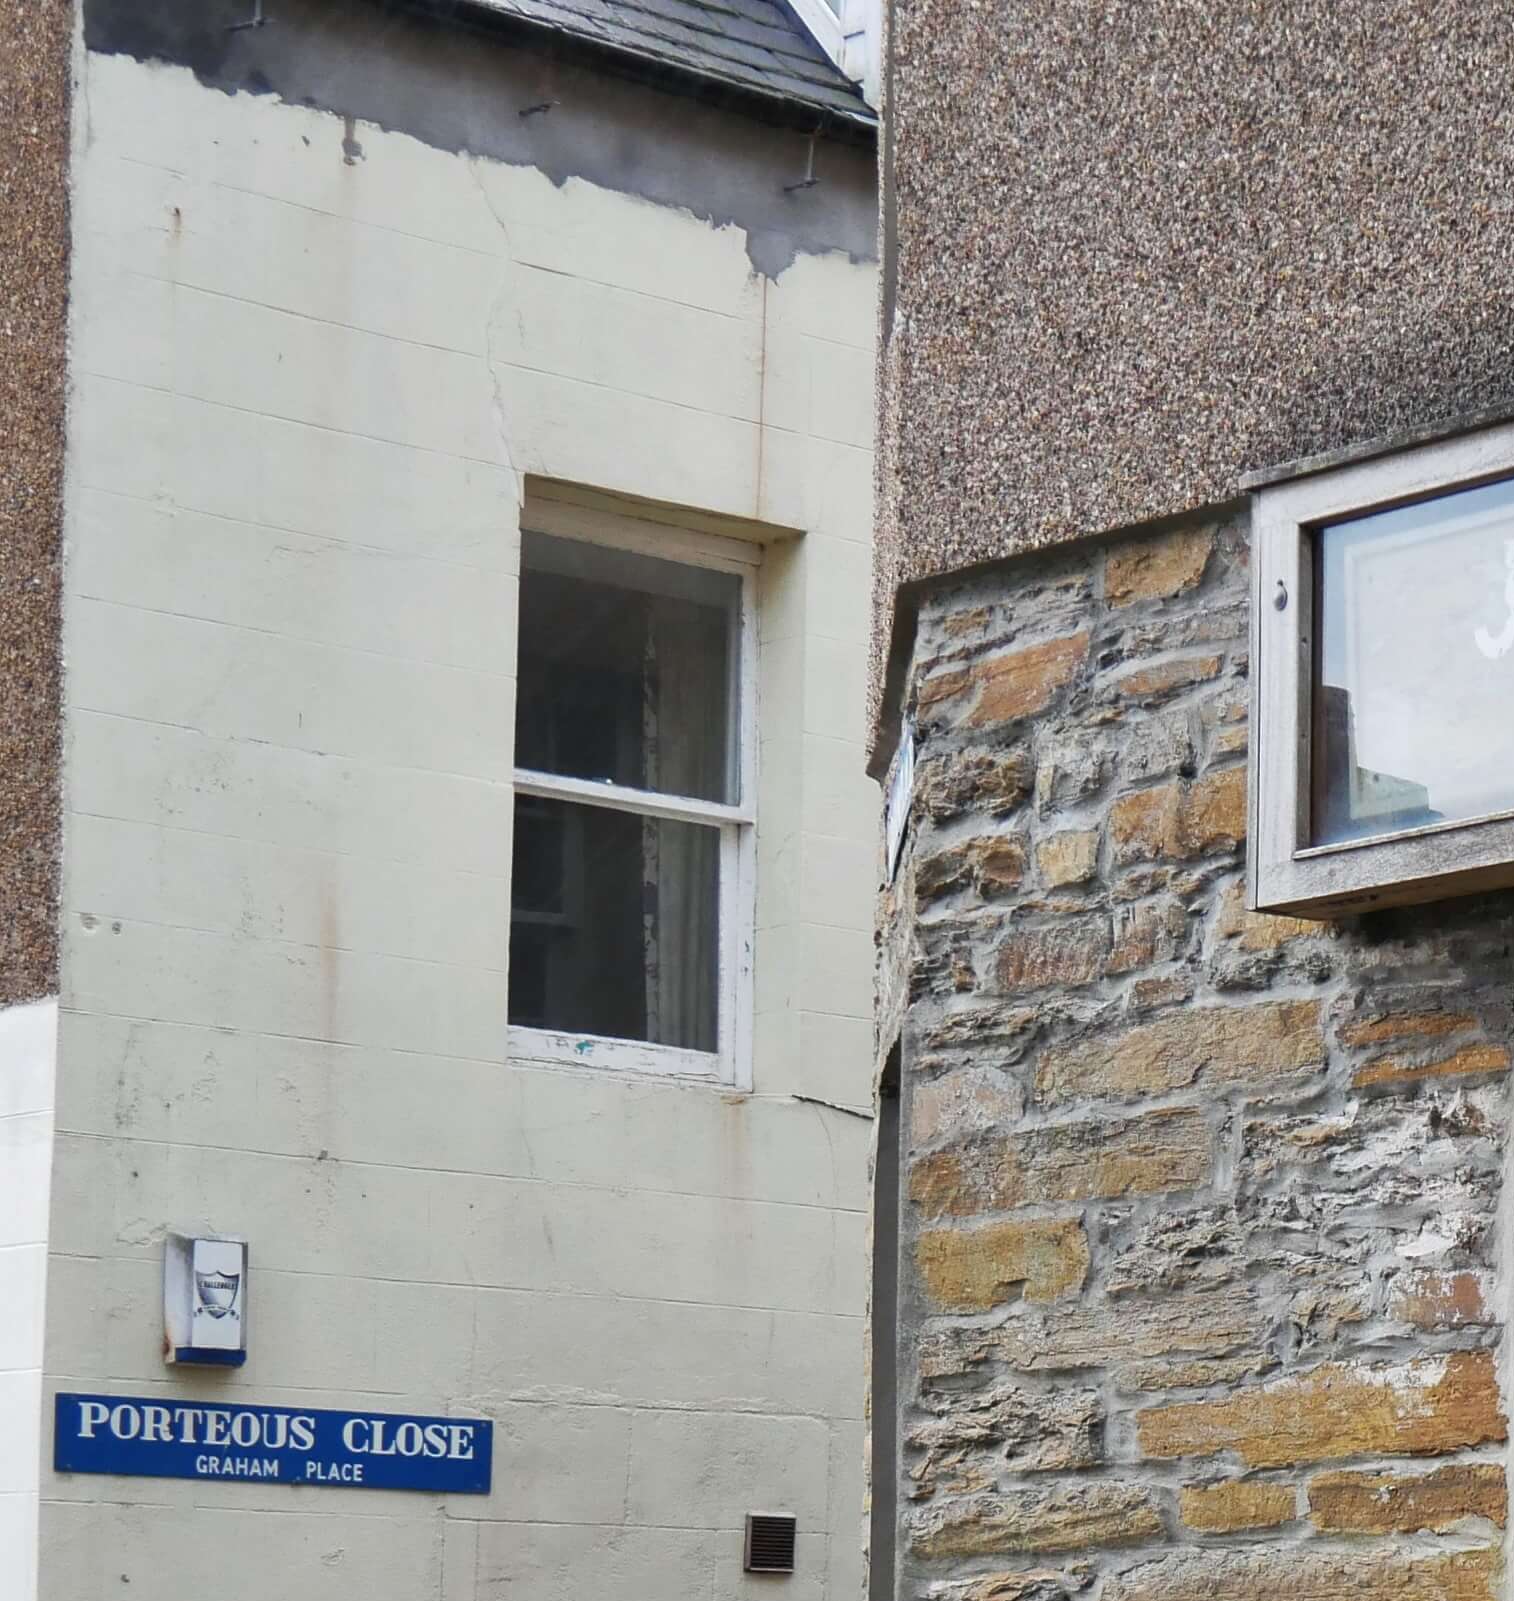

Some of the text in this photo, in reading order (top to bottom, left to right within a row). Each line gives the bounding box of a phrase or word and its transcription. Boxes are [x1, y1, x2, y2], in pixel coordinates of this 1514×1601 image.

[78, 1401, 475, 1460] PORTEOUS CLOSE
[196, 1455, 364, 1482] GRAHAM PLACE
